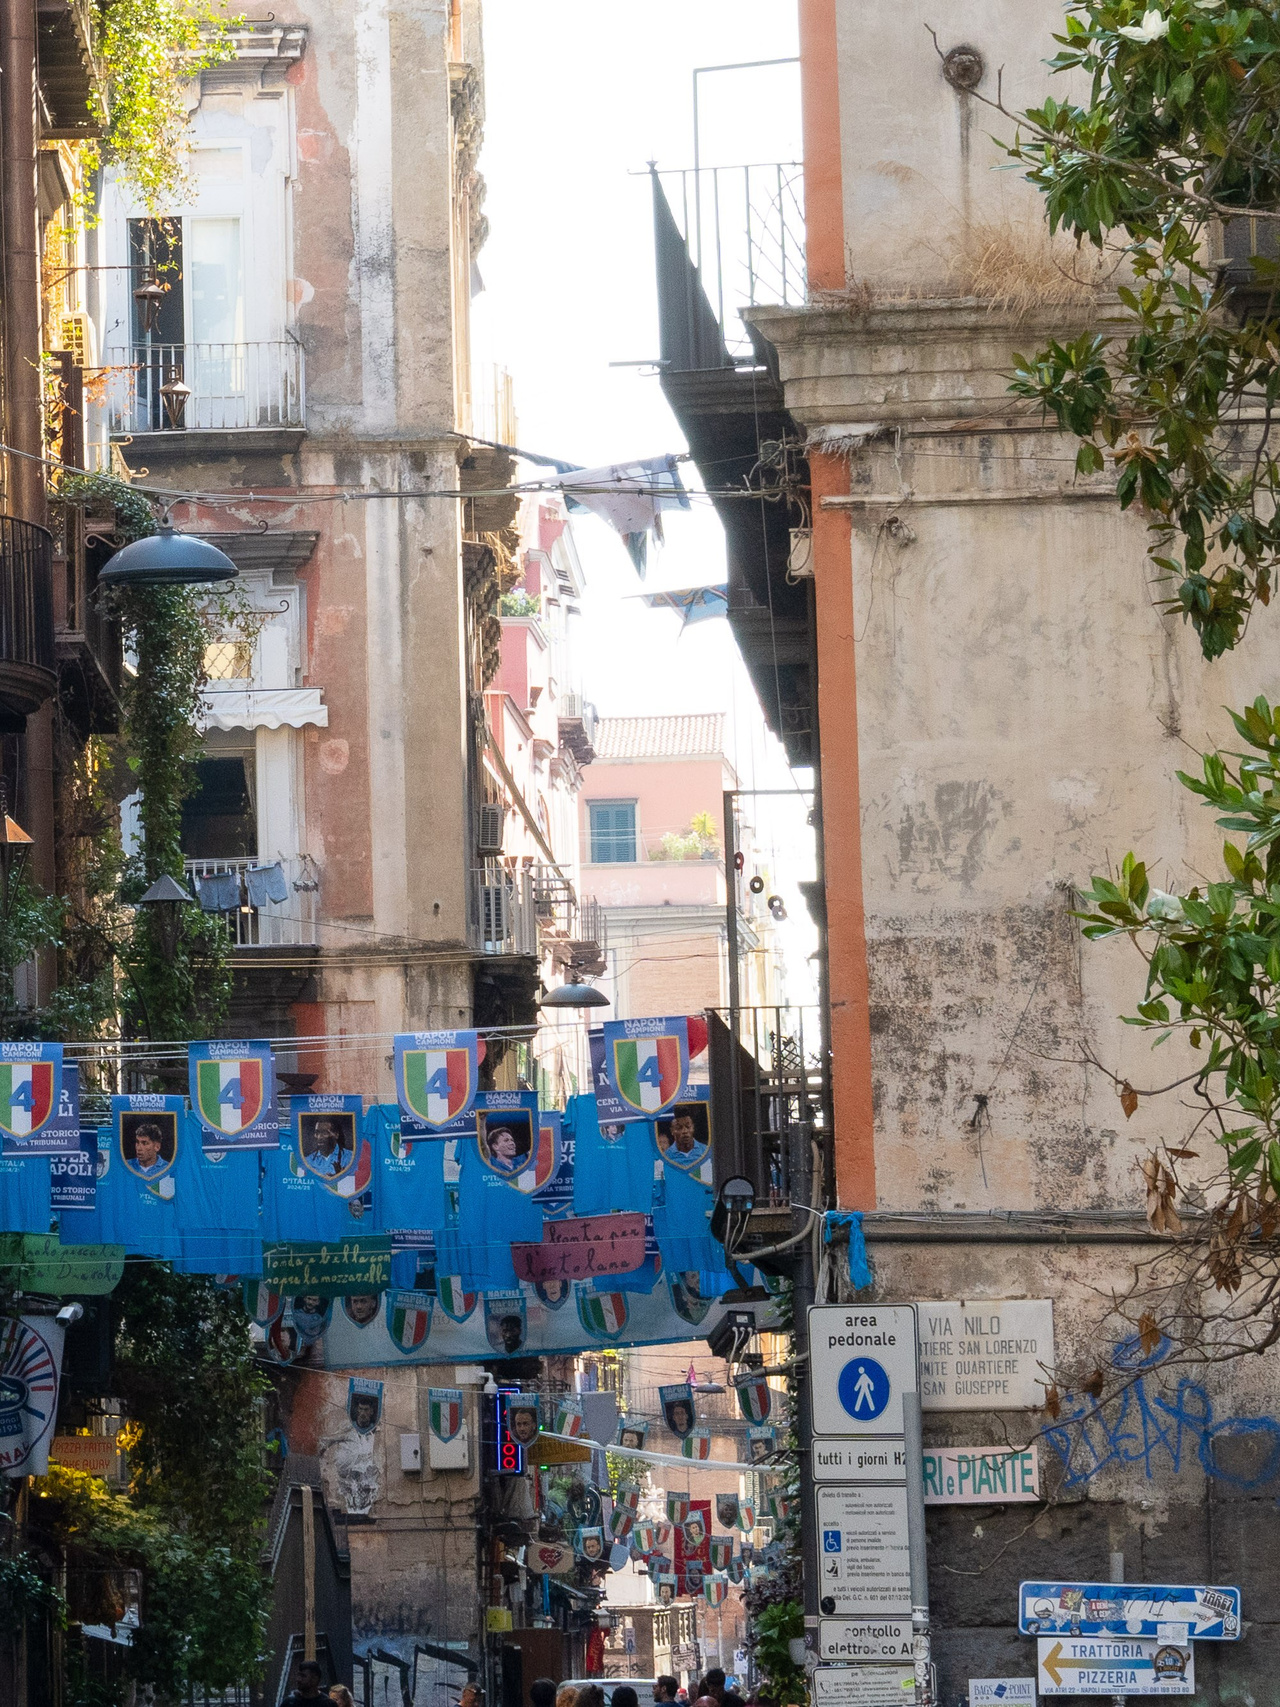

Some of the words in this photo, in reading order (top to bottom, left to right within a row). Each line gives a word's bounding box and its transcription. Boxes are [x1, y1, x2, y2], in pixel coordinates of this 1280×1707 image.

[624, 1018, 666, 1028] NAPOLI
[1, 1043, 43, 1052] NAPOLI
[208, 1042, 250, 1050] NAPOLI
[636, 1056, 664, 1088] 4
[426, 1067, 452, 1100] 4
[8, 1080, 36, 1112] 4
[218, 1078, 245, 1110] 4
[596, 1097, 619, 1107] CENT
[40, 1130, 80, 1138] STORICO
[50, 1163, 93, 1176] APOLI
[845, 1315, 878, 1327] area
[928, 1317, 953, 1336] VIA
[964, 1316, 1001, 1336] NILO
[828, 1332, 896, 1348] pedonale
[958, 1341, 981, 1355] SAN
[985, 1339, 1037, 1355] LORENZO
[956, 1359, 1019, 1379] QUARTIERE
[923, 1381, 946, 1396] SAN
[955, 1380, 1010, 1396] GIUSEPPE
[817, 1453, 842, 1466] tutti
[848, 1452, 852, 1466] i
[857, 1452, 888, 1468] giorni
[946, 1475, 955, 1496] e
[958, 1452, 1034, 1496] PIANTE
[1070, 1644, 1143, 1658] TRATTORIA
[1078, 1671, 1137, 1684] PIZZERIA
[974, 1684, 993, 1695] BAGS
[1008, 1684, 1031, 1694] POINT
